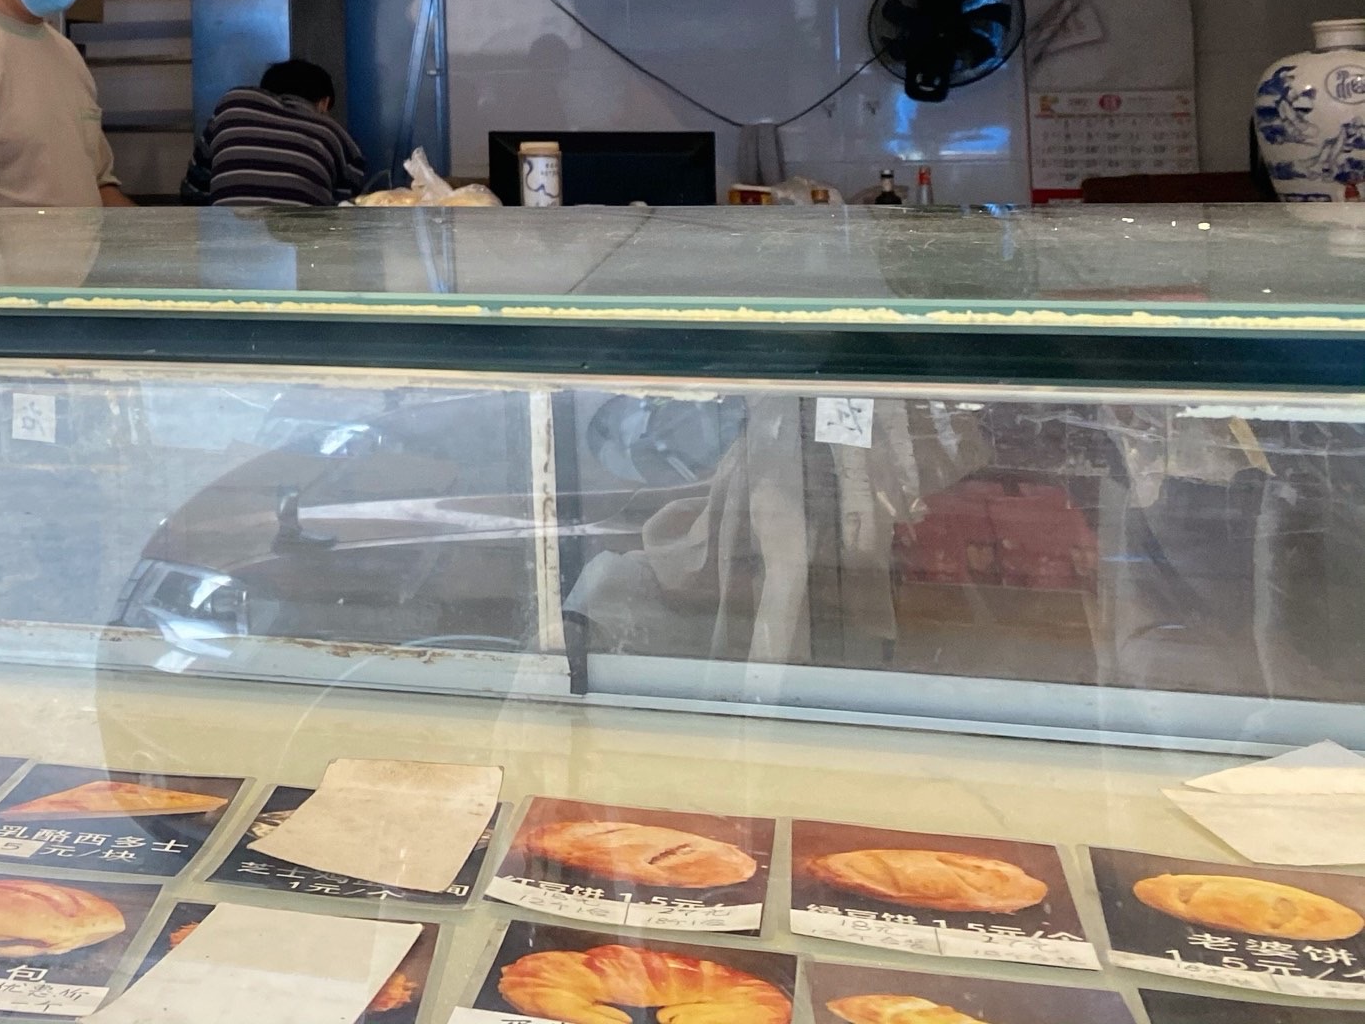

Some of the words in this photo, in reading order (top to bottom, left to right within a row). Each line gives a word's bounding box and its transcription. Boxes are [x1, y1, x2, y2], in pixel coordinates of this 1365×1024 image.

[288, 879, 404, 902] 1元/个
[1186, 931, 1359, 968] 老婆饼
